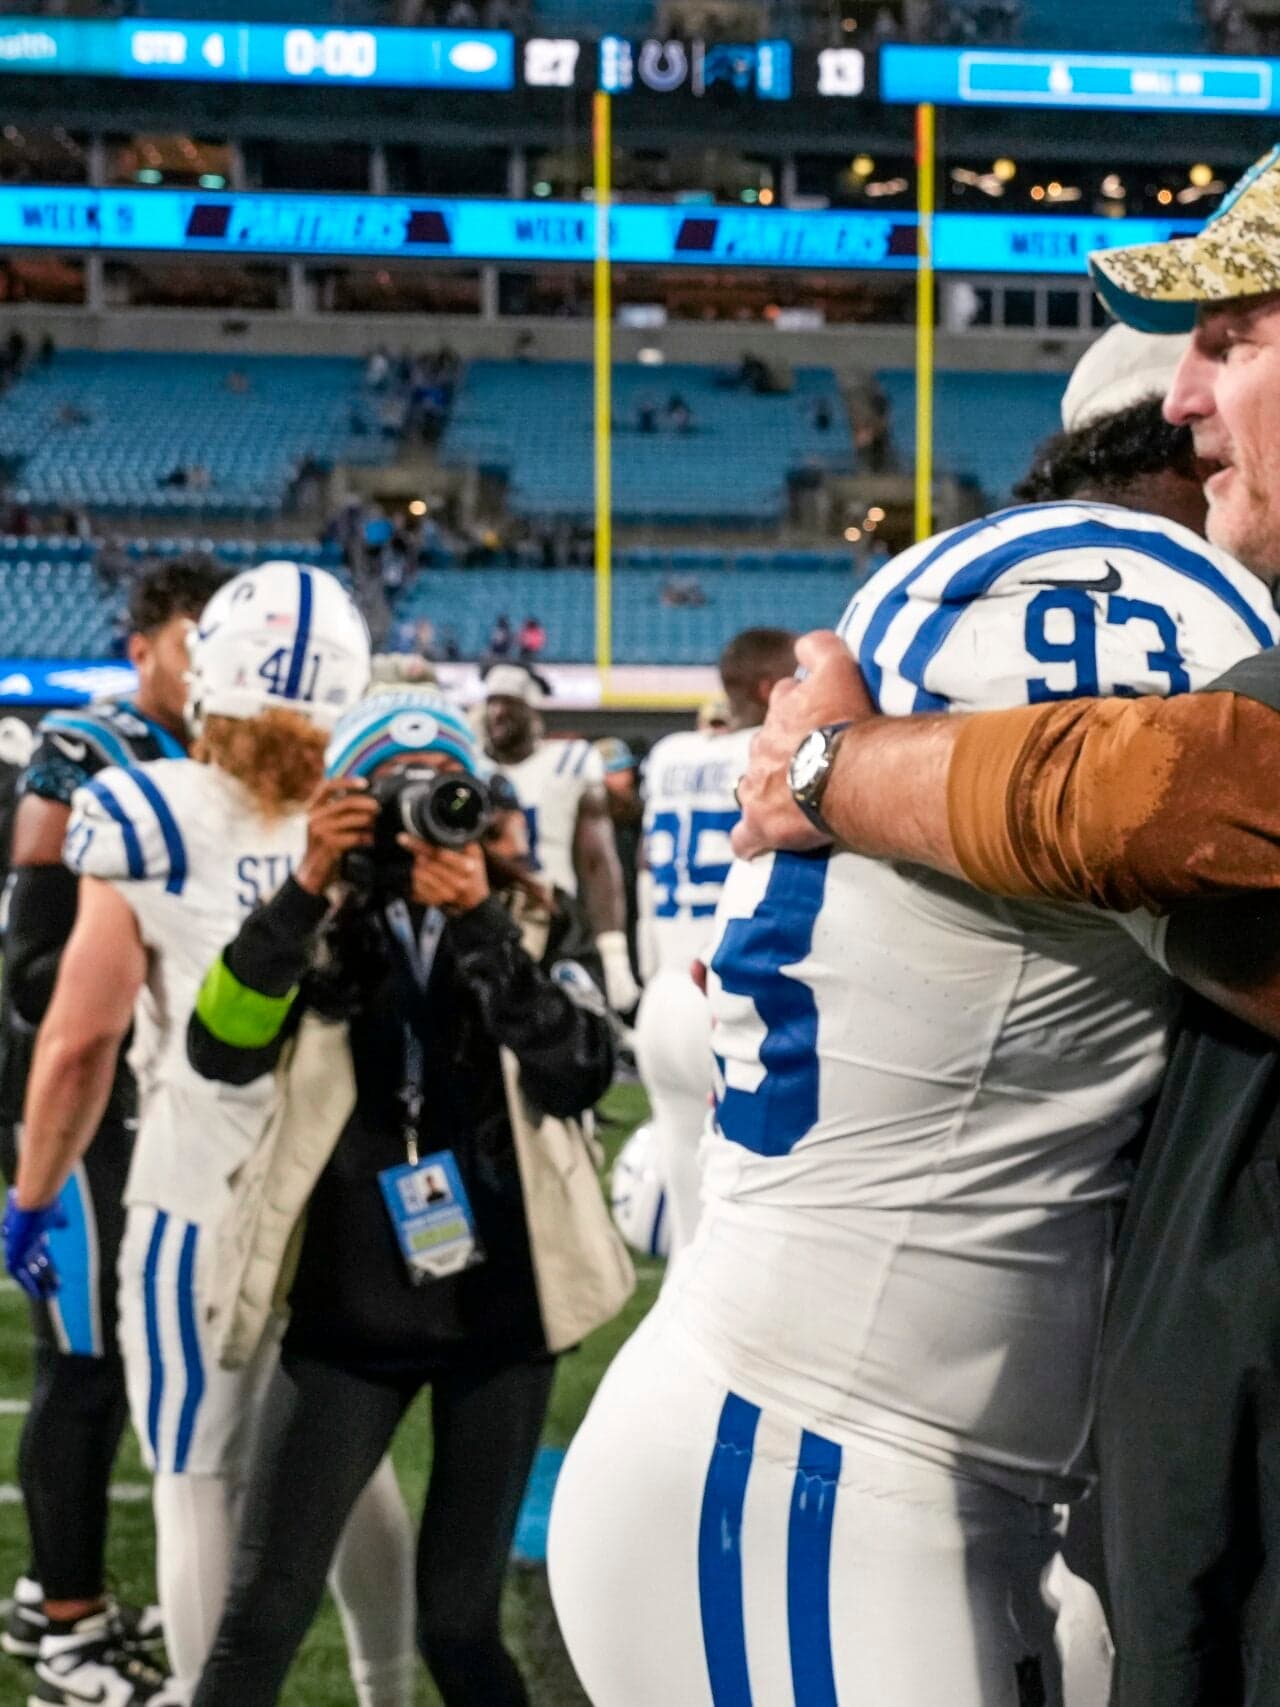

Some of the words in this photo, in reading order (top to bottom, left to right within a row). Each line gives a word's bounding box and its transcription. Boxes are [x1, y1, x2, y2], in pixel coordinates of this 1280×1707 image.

[284, 28, 377, 78] 0:00
[21, 203, 101, 231] WEEK
[231, 200, 410, 249] PANTHERS
[514, 217, 586, 245] WEEK
[716, 214, 893, 263] PANTHERS
[1024, 586, 1190, 705] 93
[258, 646, 321, 702] 41
